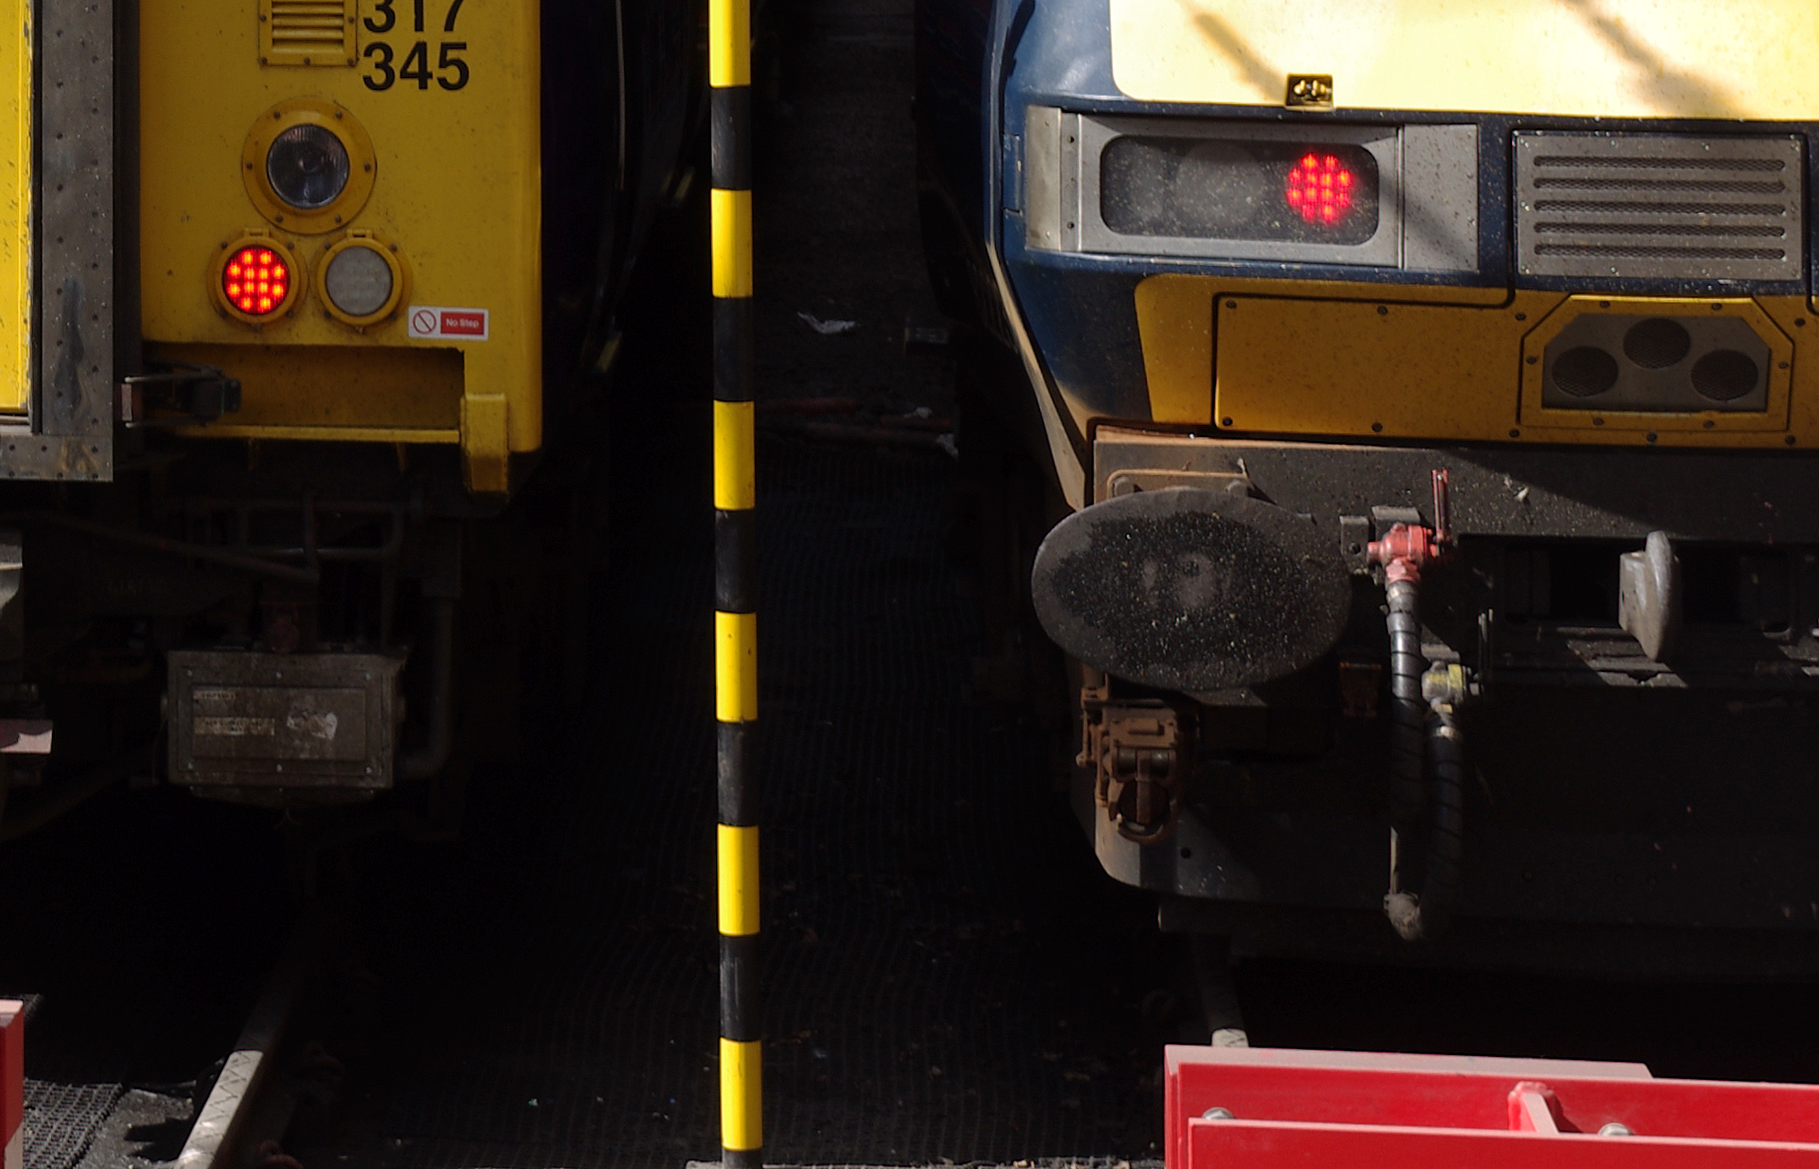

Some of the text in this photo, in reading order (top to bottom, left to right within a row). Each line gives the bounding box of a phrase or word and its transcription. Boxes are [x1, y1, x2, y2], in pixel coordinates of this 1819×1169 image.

[362, 41, 470, 91] 345
[445, 317, 480, 330] No Step
